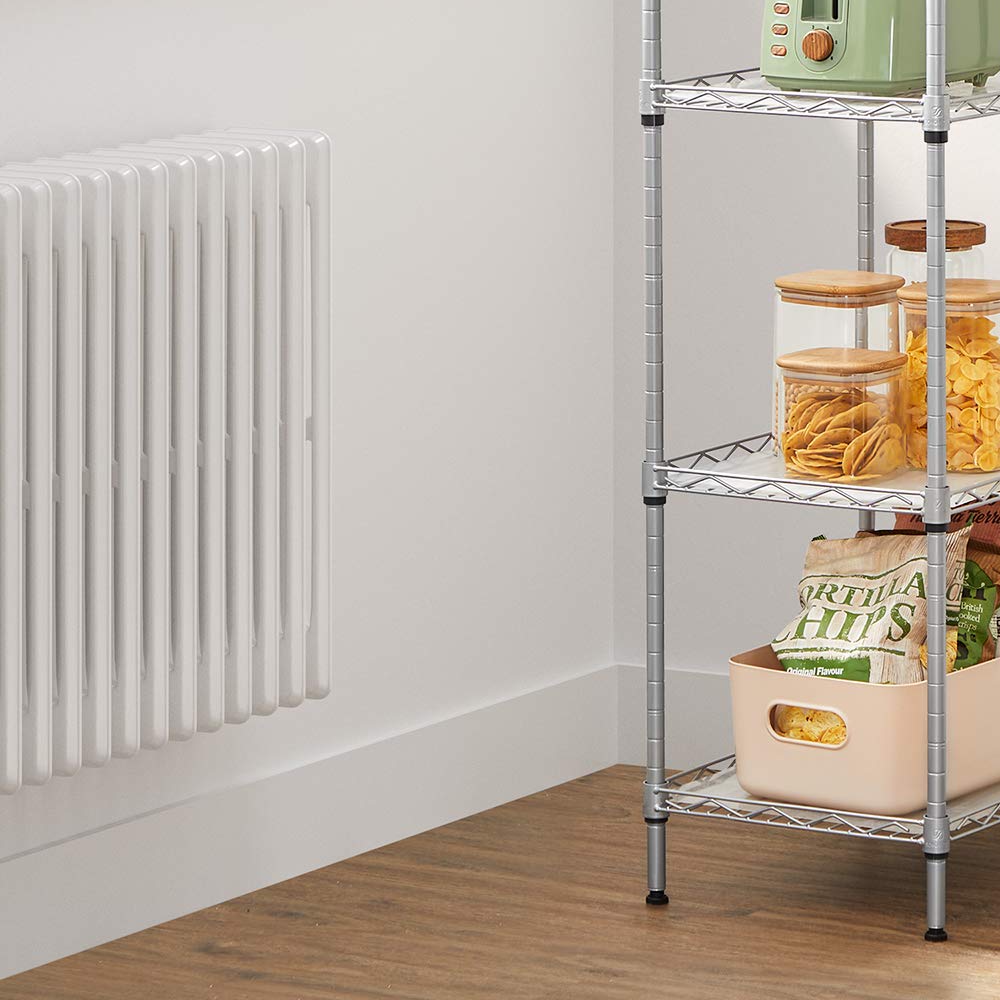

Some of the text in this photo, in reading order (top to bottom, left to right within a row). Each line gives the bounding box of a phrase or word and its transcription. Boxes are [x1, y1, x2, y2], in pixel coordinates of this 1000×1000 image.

[800, 571, 927, 607] ORTILLA
[960, 602, 984, 613] British
[958, 612, 981, 624] ooked
[786, 666, 844, 677] Original Flavour
